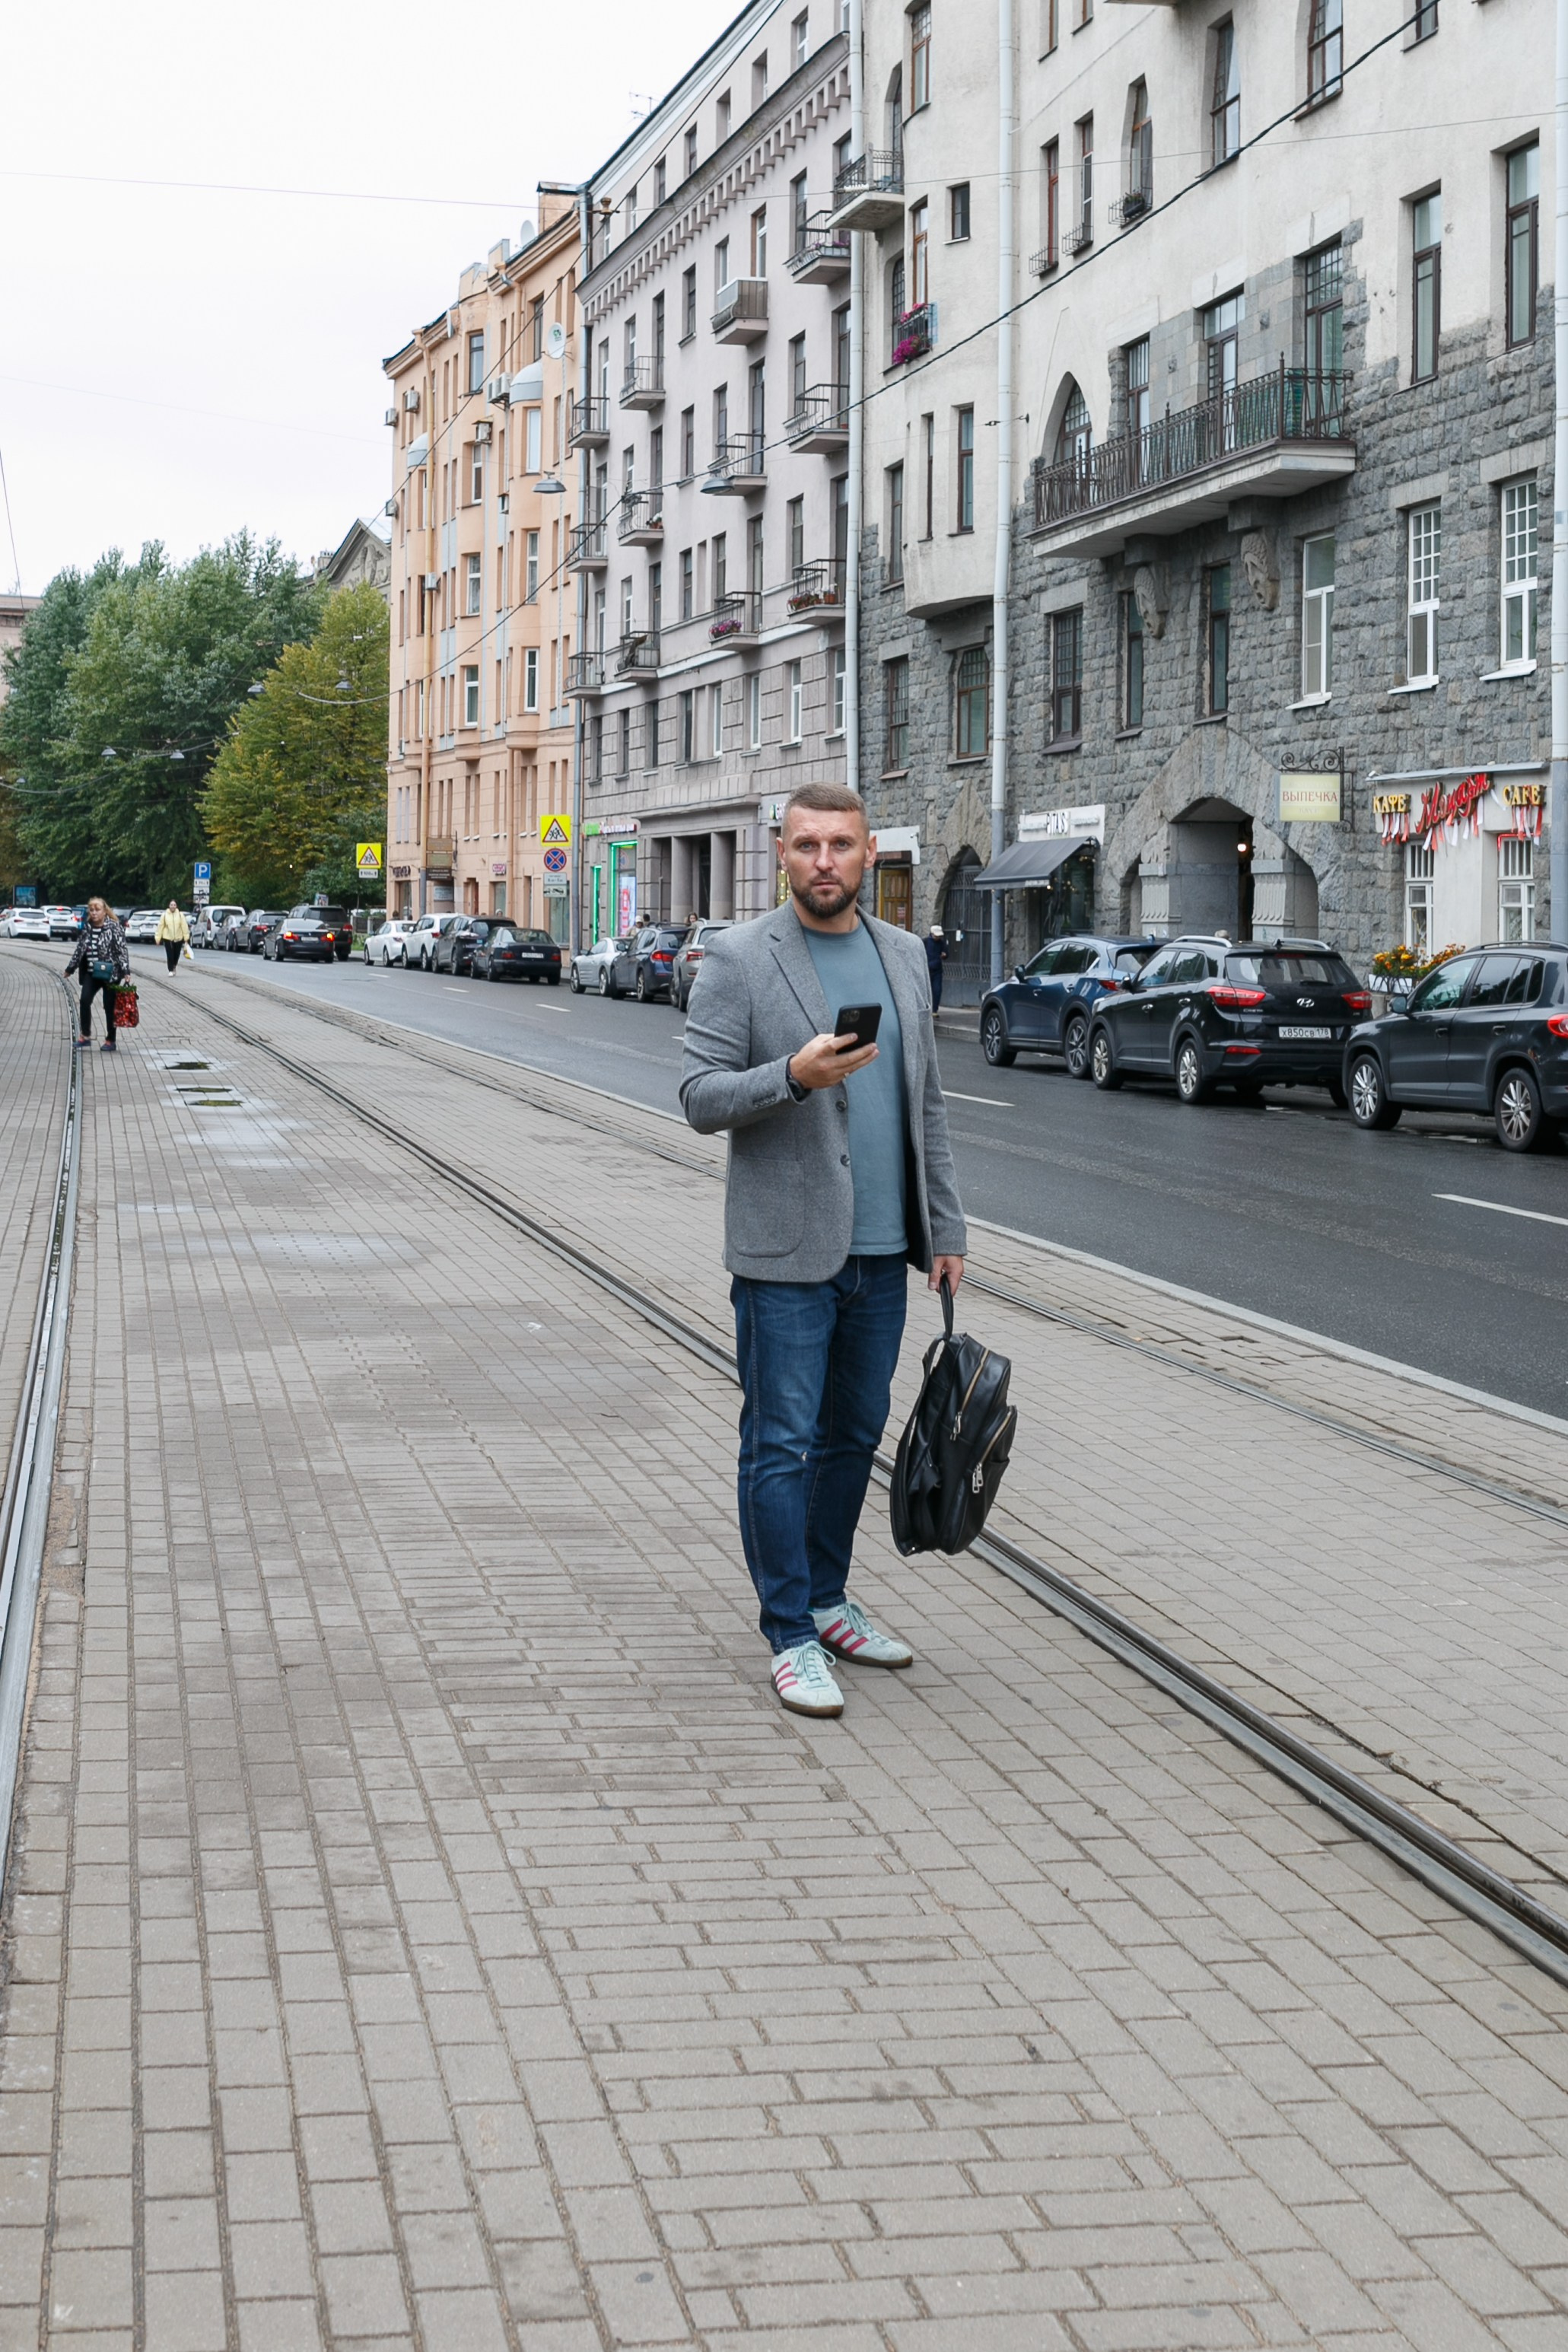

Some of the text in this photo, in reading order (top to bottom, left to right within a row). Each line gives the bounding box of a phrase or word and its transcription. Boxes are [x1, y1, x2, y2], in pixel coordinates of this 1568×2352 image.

[1282, 791, 1338, 802] ВЫПЕЧКА
[1503, 785, 1542, 807] CAFE
[1372, 794, 1407, 814] КАФЕ
[199, 864, 208, 877] P
[1316, 1027, 1329, 1036] 178
